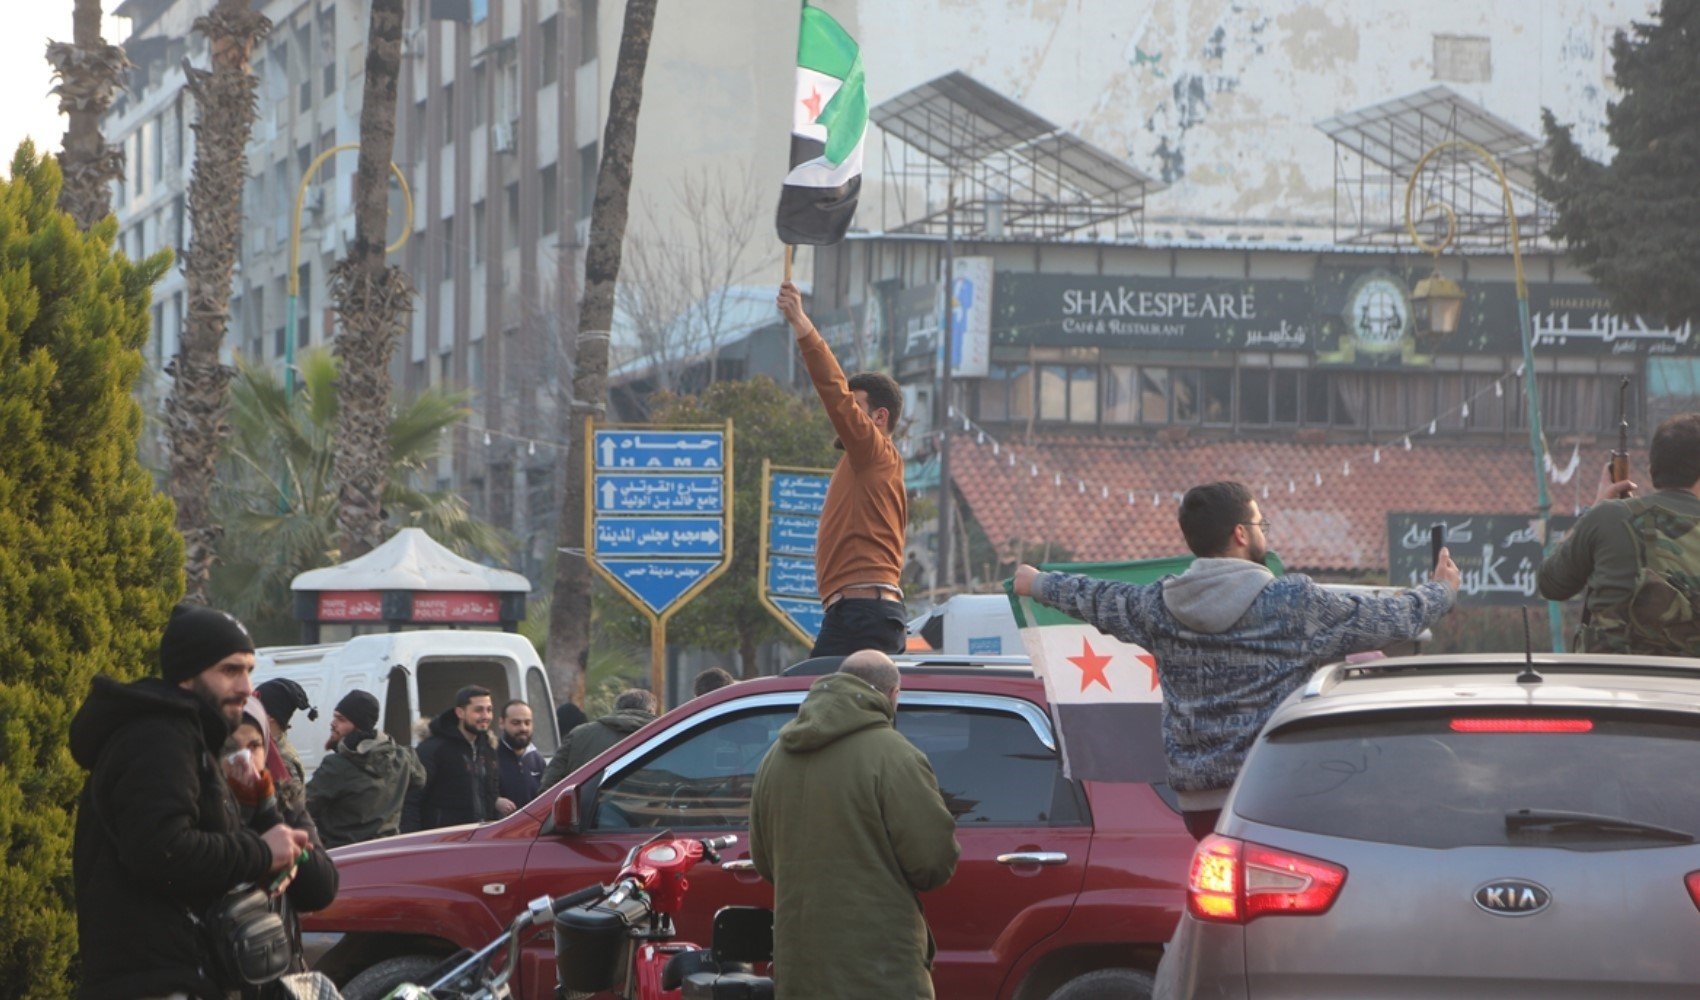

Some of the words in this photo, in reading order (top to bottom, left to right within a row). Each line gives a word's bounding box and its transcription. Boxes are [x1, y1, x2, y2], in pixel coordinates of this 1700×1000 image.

[1062, 286, 1256, 319] SHAKESPEARE
[620, 457, 718, 466] HAMA
[620, 480, 674, 495] القوتلي
[677, 478, 718, 495] شارع
[621, 496, 651, 508] الوليد
[653, 496, 670, 509] بن
[673, 496, 694, 506] خالد
[598, 526, 635, 546] المدينة
[637, 528, 670, 545] مجلس
[672, 531, 700, 547] مجمع
[415, 608, 447, 618] POLICE
[1487, 887, 1538, 908] KIA
